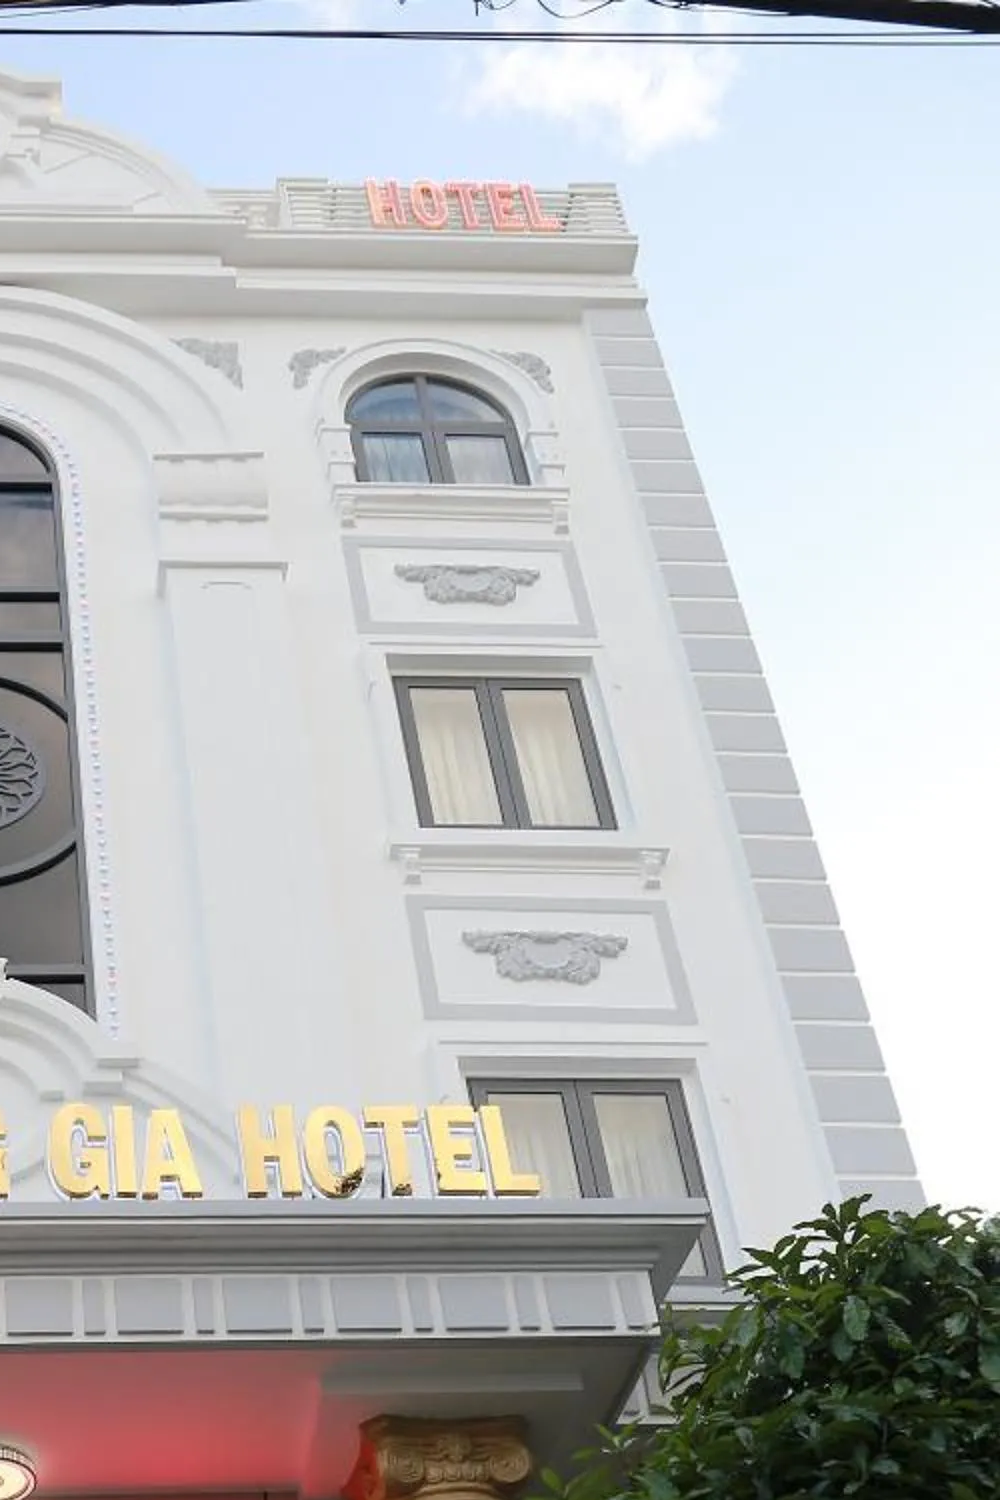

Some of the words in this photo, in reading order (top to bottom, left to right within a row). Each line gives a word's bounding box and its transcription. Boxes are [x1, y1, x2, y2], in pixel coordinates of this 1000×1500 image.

[364, 176, 564, 234] HOTEL
[48, 1104, 203, 1201] GIA
[236, 1104, 541, 1200] HOTEL
